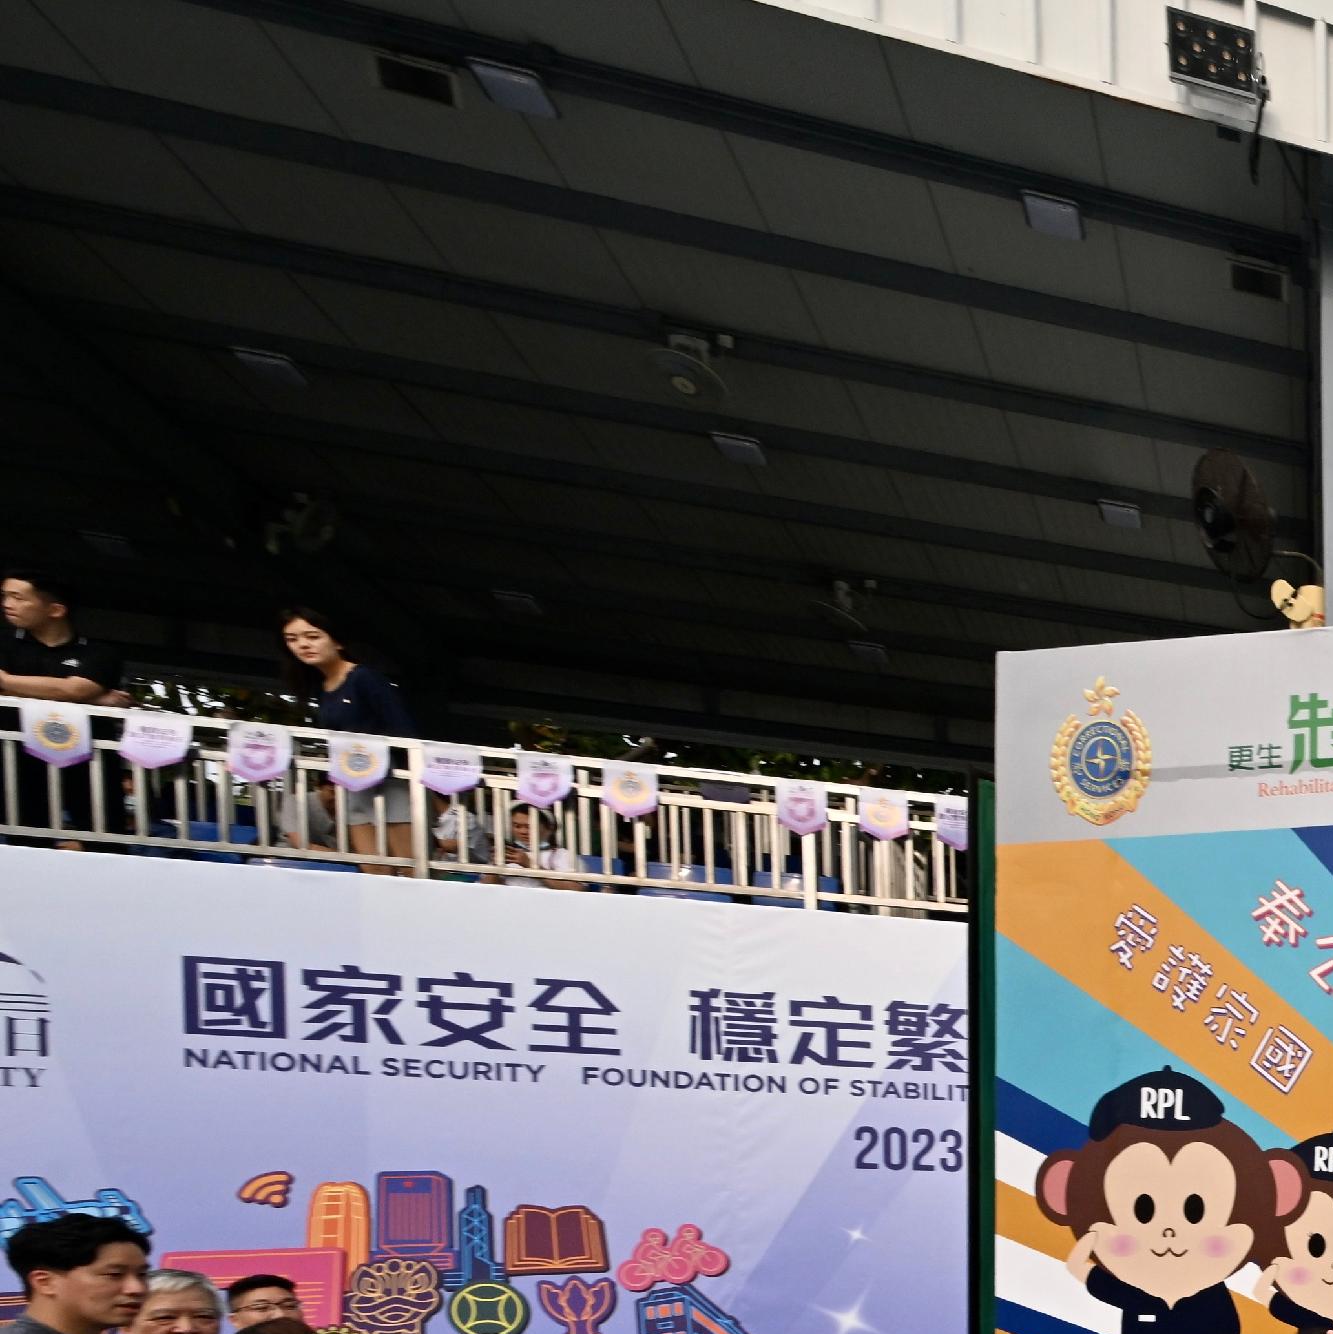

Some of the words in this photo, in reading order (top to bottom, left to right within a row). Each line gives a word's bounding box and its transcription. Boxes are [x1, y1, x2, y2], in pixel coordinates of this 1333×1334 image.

[182, 955, 622, 1056] 國家安全
[1109, 903, 1314, 1095] 愛護家國
[183, 1047, 371, 1076] NATIONAL
[381, 1056, 546, 1083] SECURITY
[581, 1066, 788, 1094] FOUNDATION
[798, 1076, 840, 1096] OF
[1140, 1087, 1192, 1122] RPL
[854, 1125, 964, 1172] 2023
